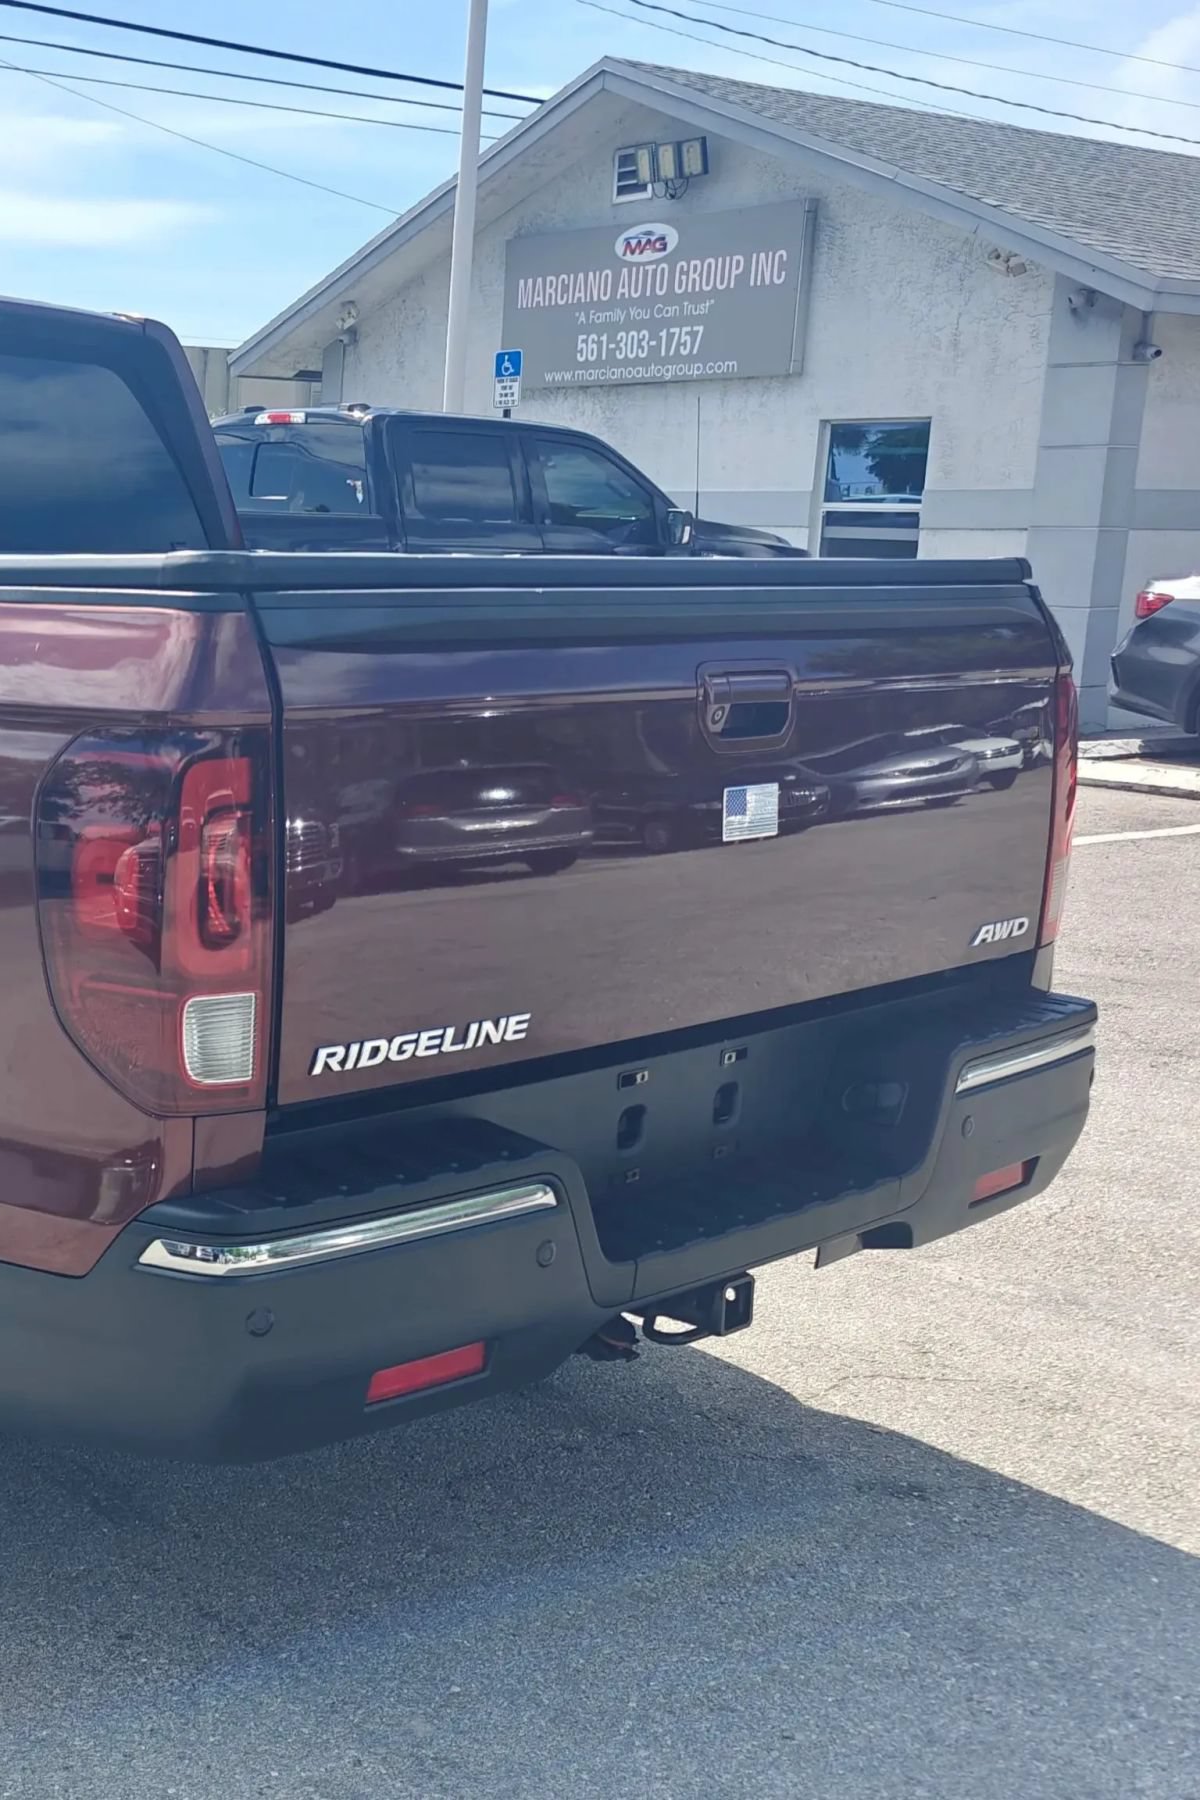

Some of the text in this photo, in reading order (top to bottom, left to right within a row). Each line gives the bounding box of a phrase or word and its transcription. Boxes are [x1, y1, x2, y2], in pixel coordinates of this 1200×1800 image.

[621, 234, 668, 257] MAG
[517, 249, 788, 309] MARCIANO AUTO GROUP INC
[589, 308, 627, 324] Family
[629, 306, 650, 321] You
[653, 303, 680, 319] Can
[576, 325, 704, 362] 561-303-1757
[544, 360, 737, 383] www.marcianoautogroup.com
[972, 915, 1031, 948] AWD
[309, 1011, 532, 1077] RIDGELINE
